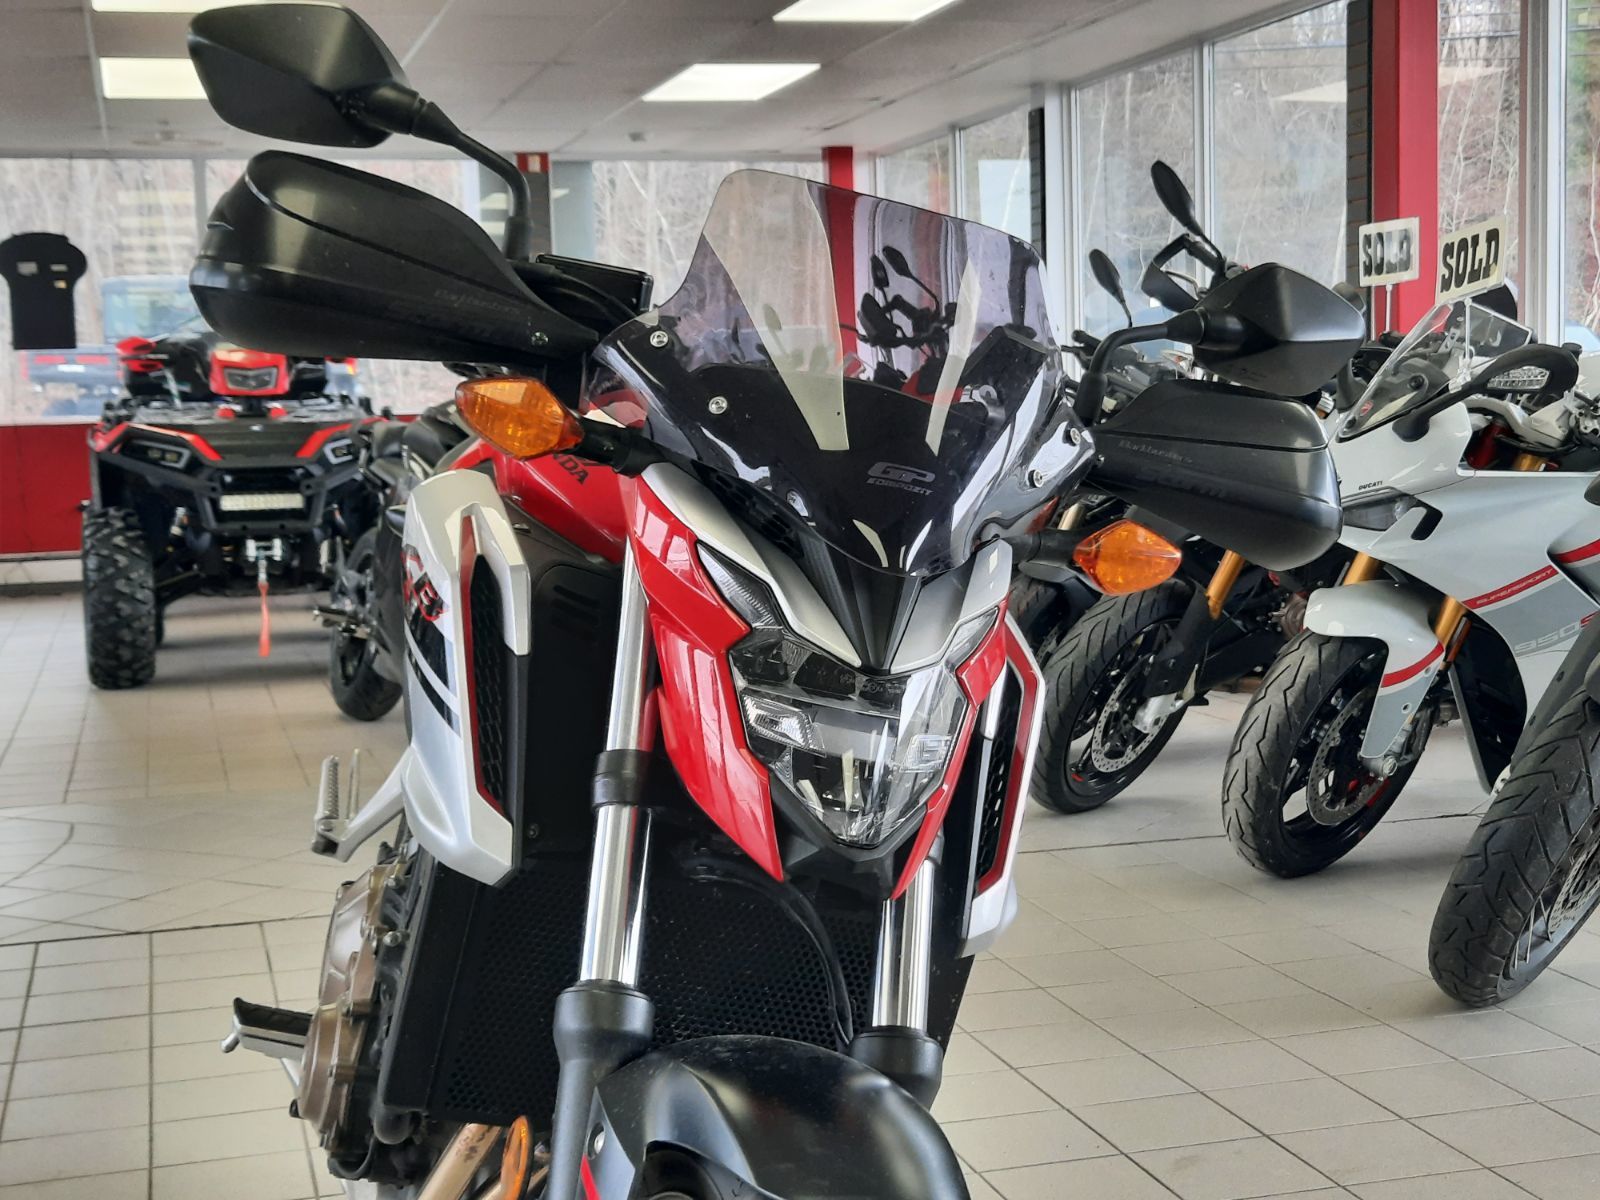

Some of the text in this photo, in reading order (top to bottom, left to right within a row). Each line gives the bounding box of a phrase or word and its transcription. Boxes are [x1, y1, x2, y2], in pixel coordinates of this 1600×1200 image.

[1362, 228, 1411, 277] SOLD
[1440, 227, 1500, 293] SOLD
[1358, 480, 1383, 491] DUCATI
[1475, 567, 1554, 605] SUPERSPORT
